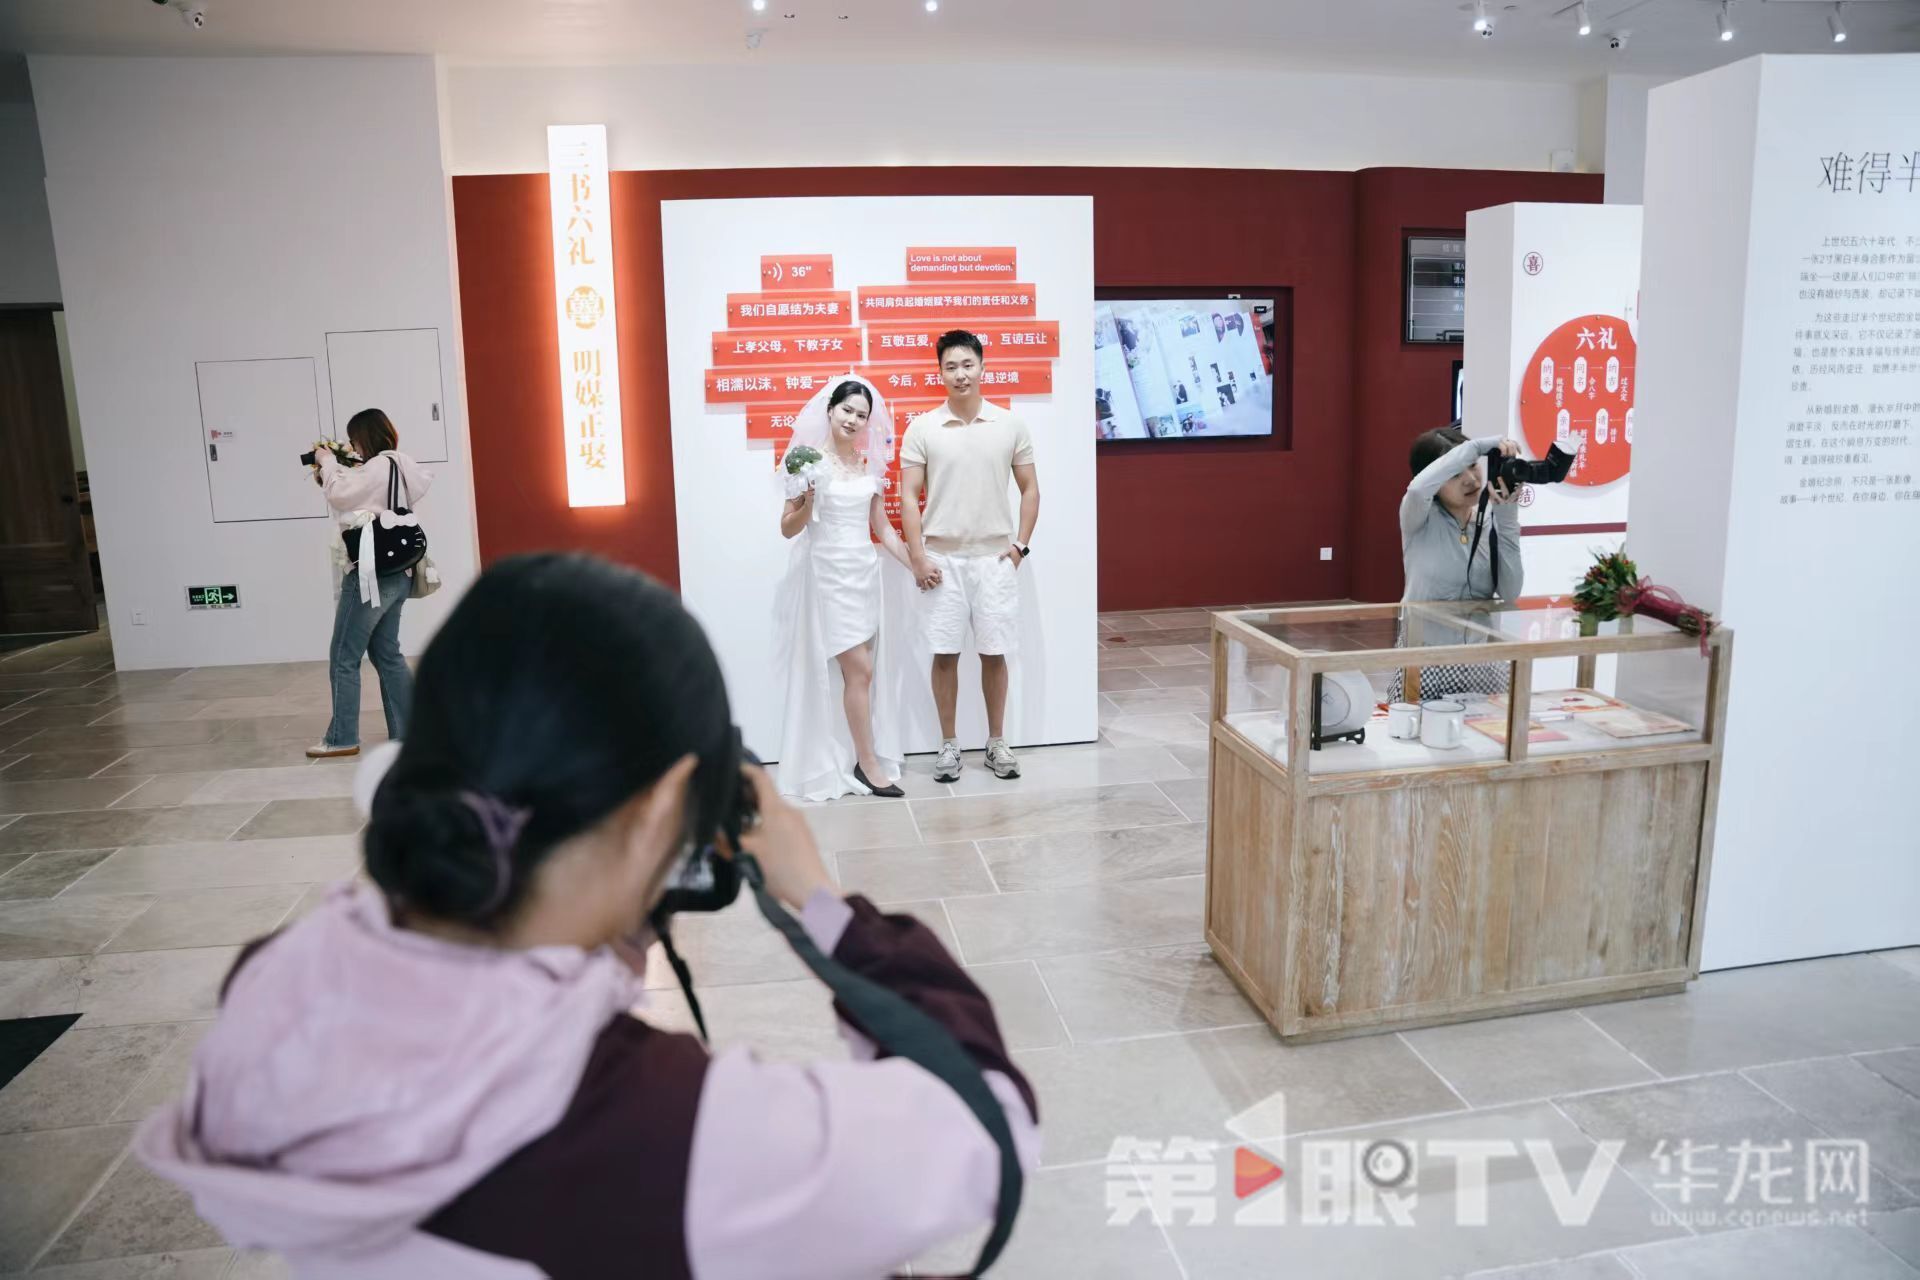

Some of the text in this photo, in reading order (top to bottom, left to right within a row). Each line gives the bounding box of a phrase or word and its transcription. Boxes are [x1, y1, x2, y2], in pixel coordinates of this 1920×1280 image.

[559, 141, 596, 266] 三书六礼
[933, 254, 941, 262] is
[958, 254, 982, 262] about
[910, 264, 958, 273] demanding
[975, 263, 1013, 272] devotion.
[866, 295, 1029, 308] 共同肩负起婚姻赋予我们的责任和义务
[740, 302, 839, 317] 我们自愿结为夫妻
[1576, 326, 1617, 350] 六礼
[732, 338, 843, 354] 上孝父母，下教子女
[572, 348, 607, 470] 明媒正娶
